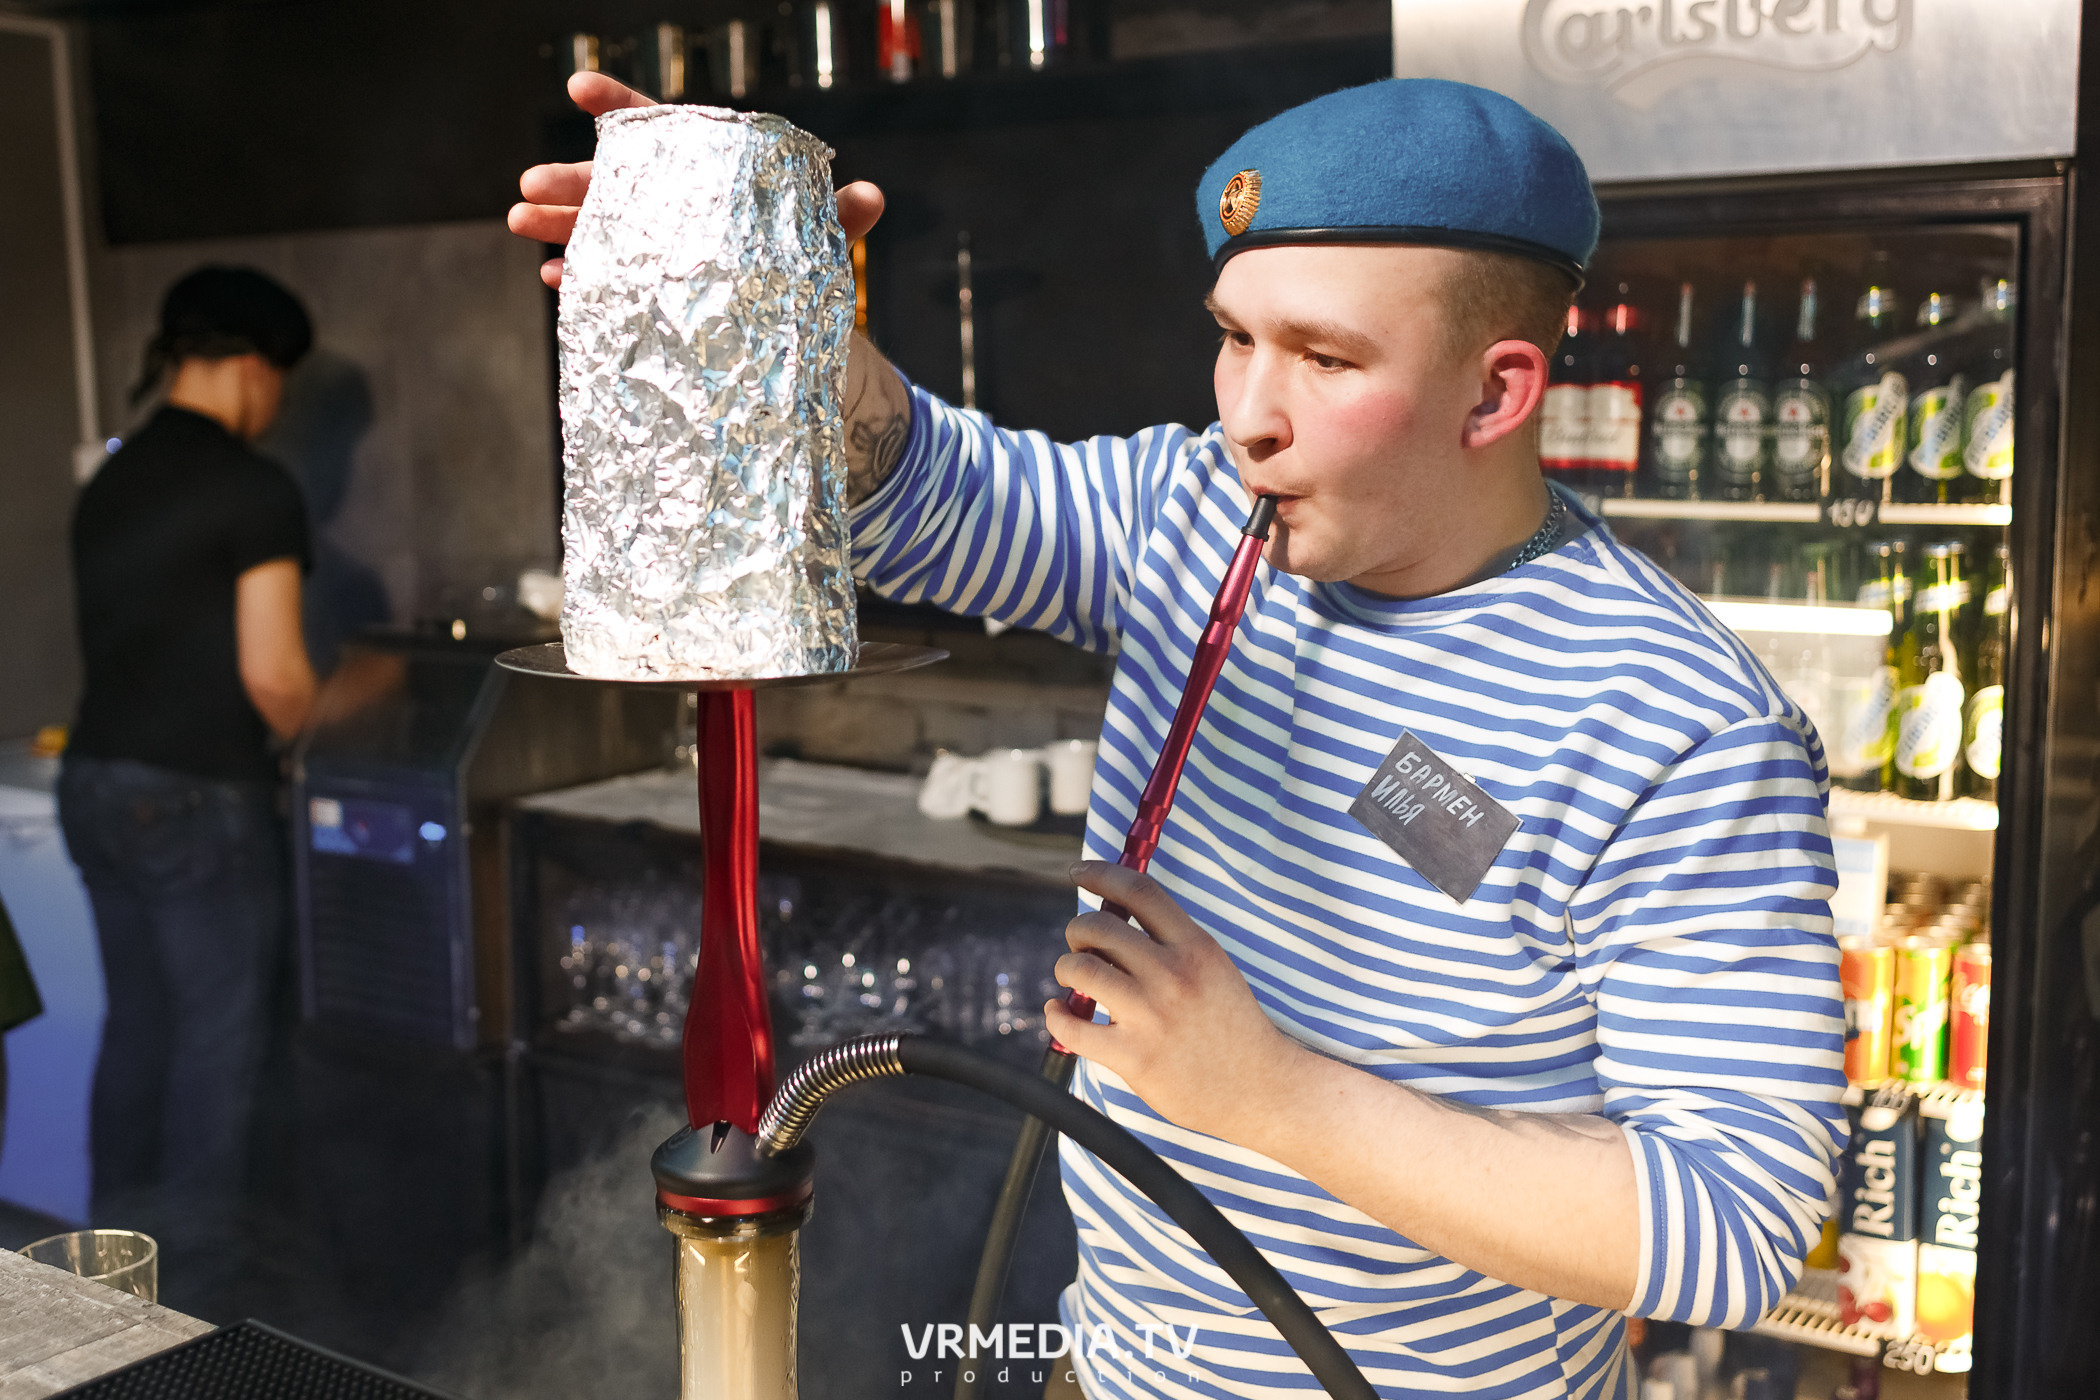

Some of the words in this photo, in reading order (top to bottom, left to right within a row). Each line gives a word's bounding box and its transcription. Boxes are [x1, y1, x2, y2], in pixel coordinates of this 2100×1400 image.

[1371, 774, 1425, 825] ИЛЬЯ
[1395, 751, 1485, 828] БАРМЕН
[1852, 1139, 1896, 1238] Rich
[1935, 1149, 1983, 1250] Rich
[1883, 1334, 1935, 1375] 250
